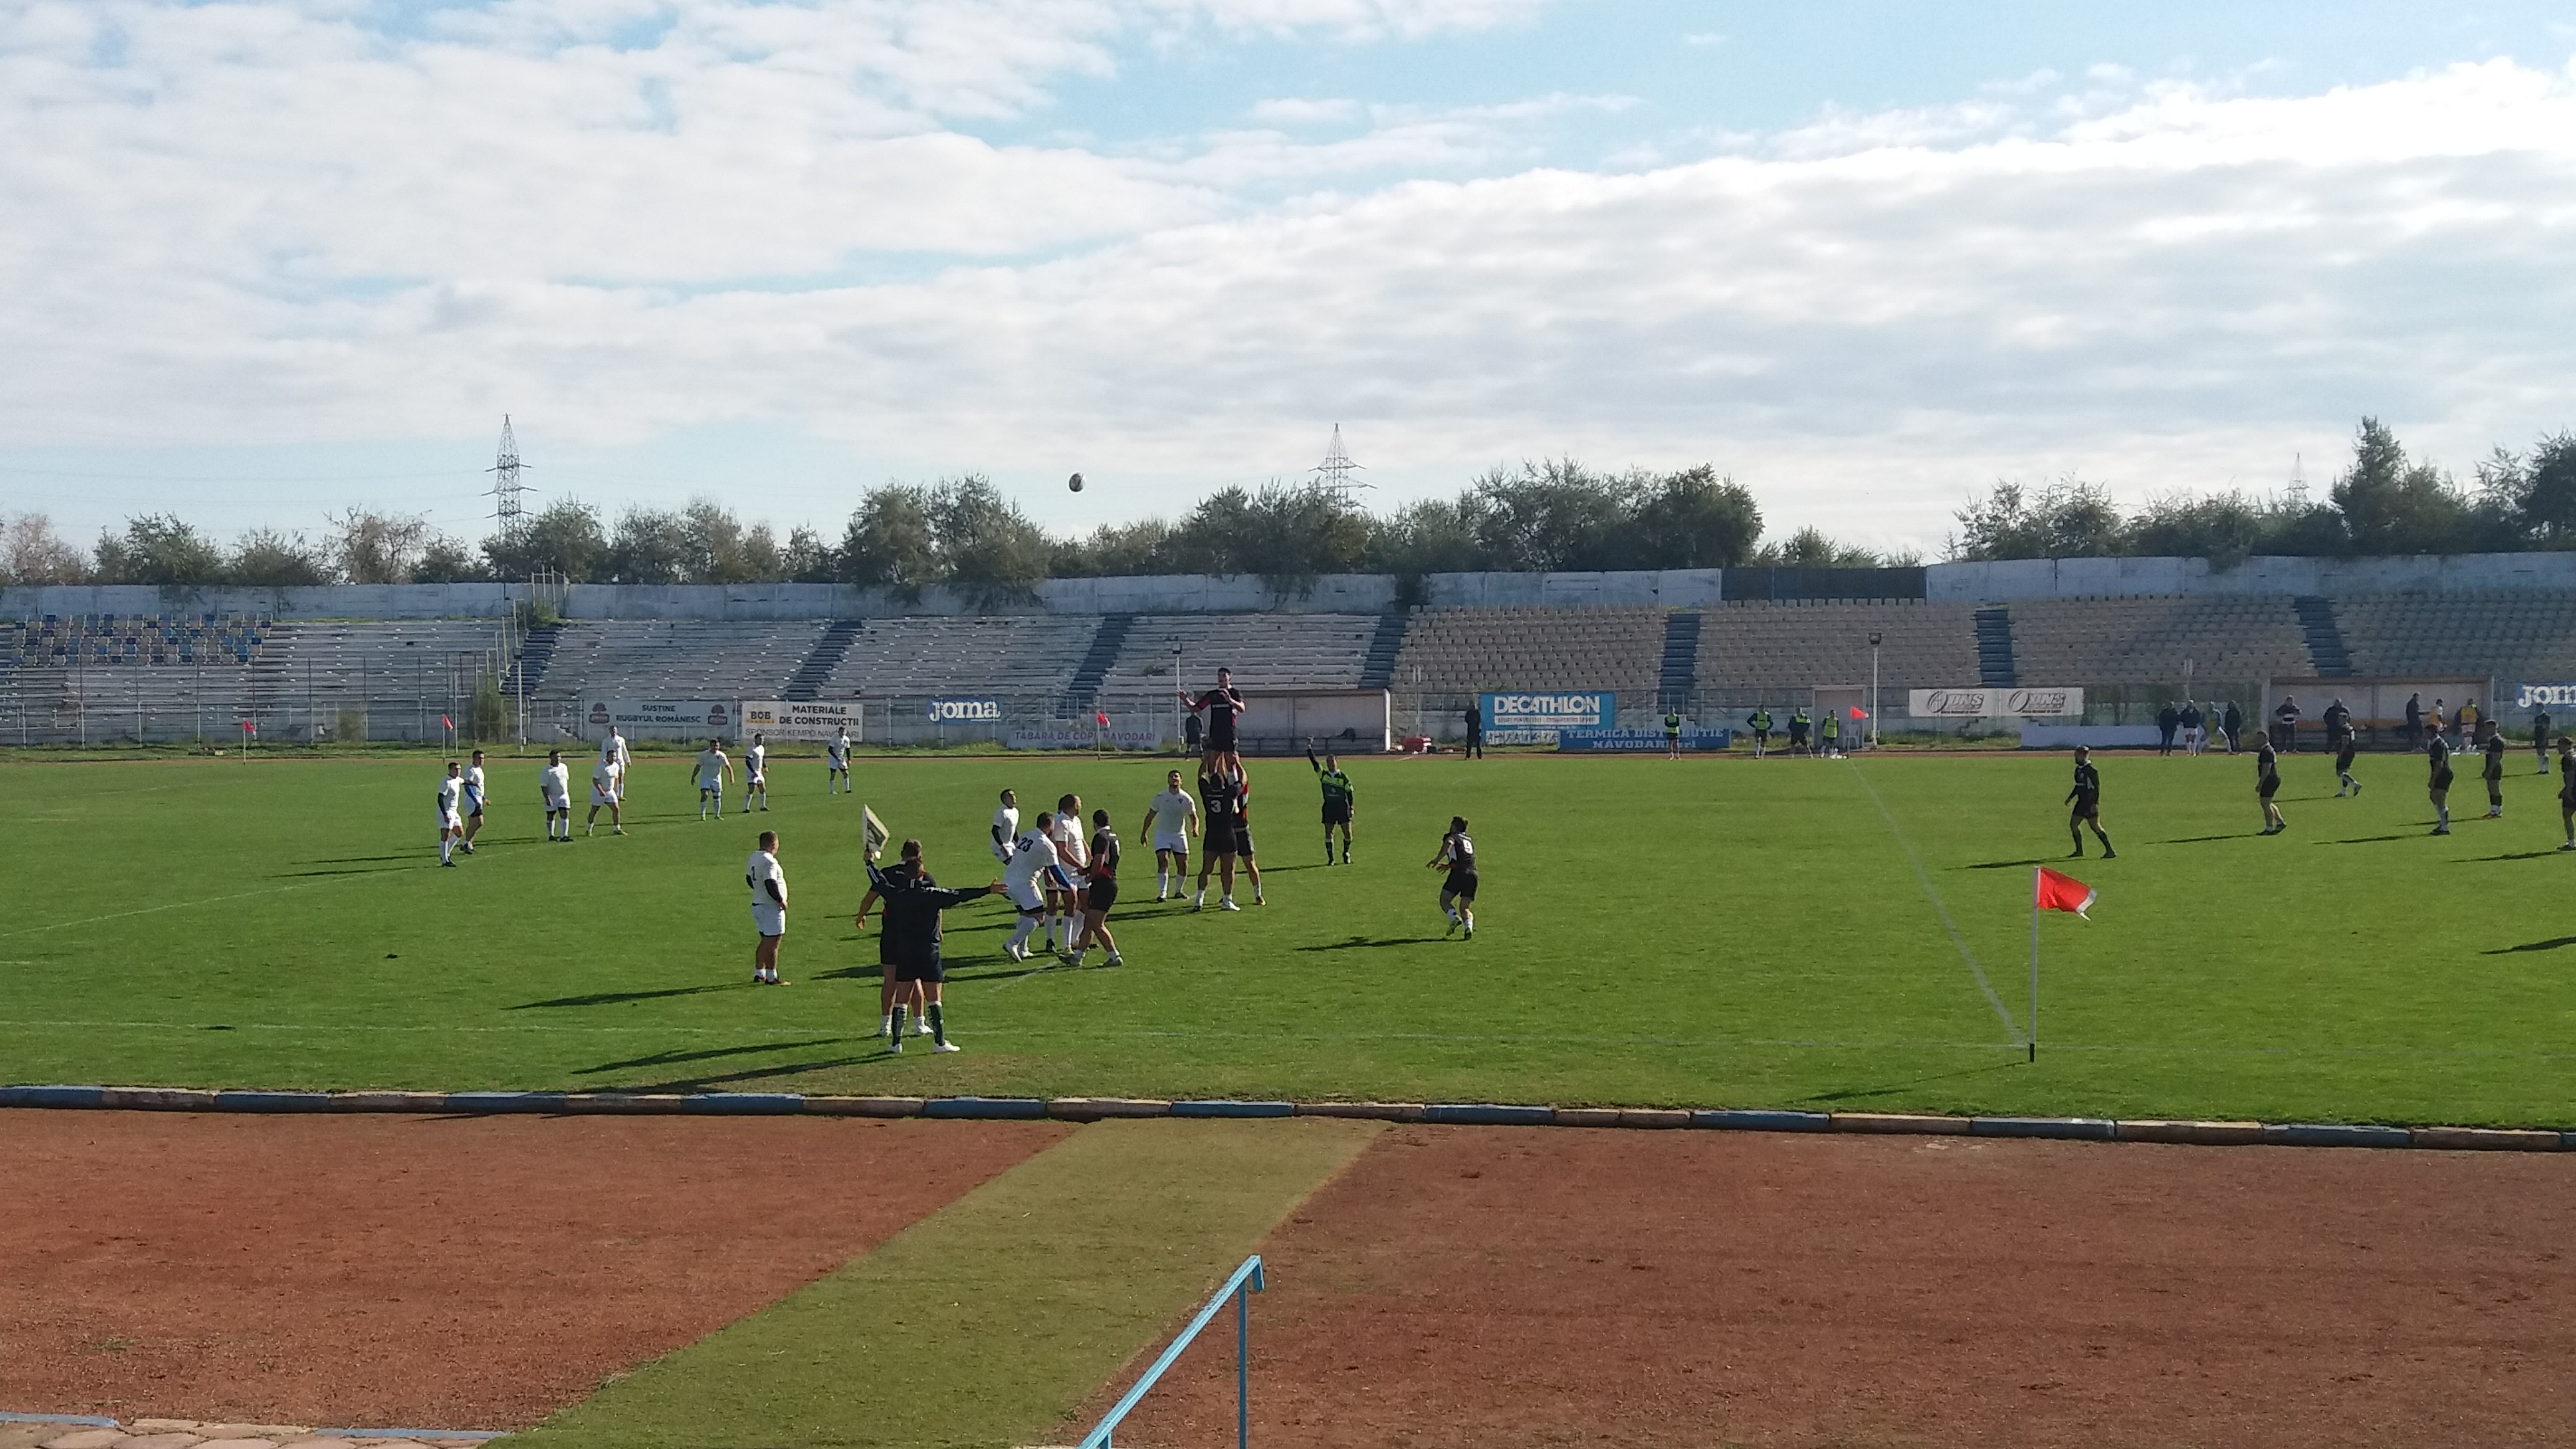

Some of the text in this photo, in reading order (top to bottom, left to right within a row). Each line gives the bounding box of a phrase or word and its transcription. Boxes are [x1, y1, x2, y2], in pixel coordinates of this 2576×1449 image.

[1494, 696, 1600, 713] DECATHLON
[792, 705, 847, 715] MATERIALE
[750, 711, 771, 720] BOB
[779, 716, 793, 724] DE
[817, 730, 860, 738] NAVARI
[1056, 732, 1070, 740] DE
[1566, 729, 1631, 739] TERMICA
[1211, 799, 1222, 813] 3
[1017, 837, 1034, 852] 23
[1463, 839, 1473, 854] 9
